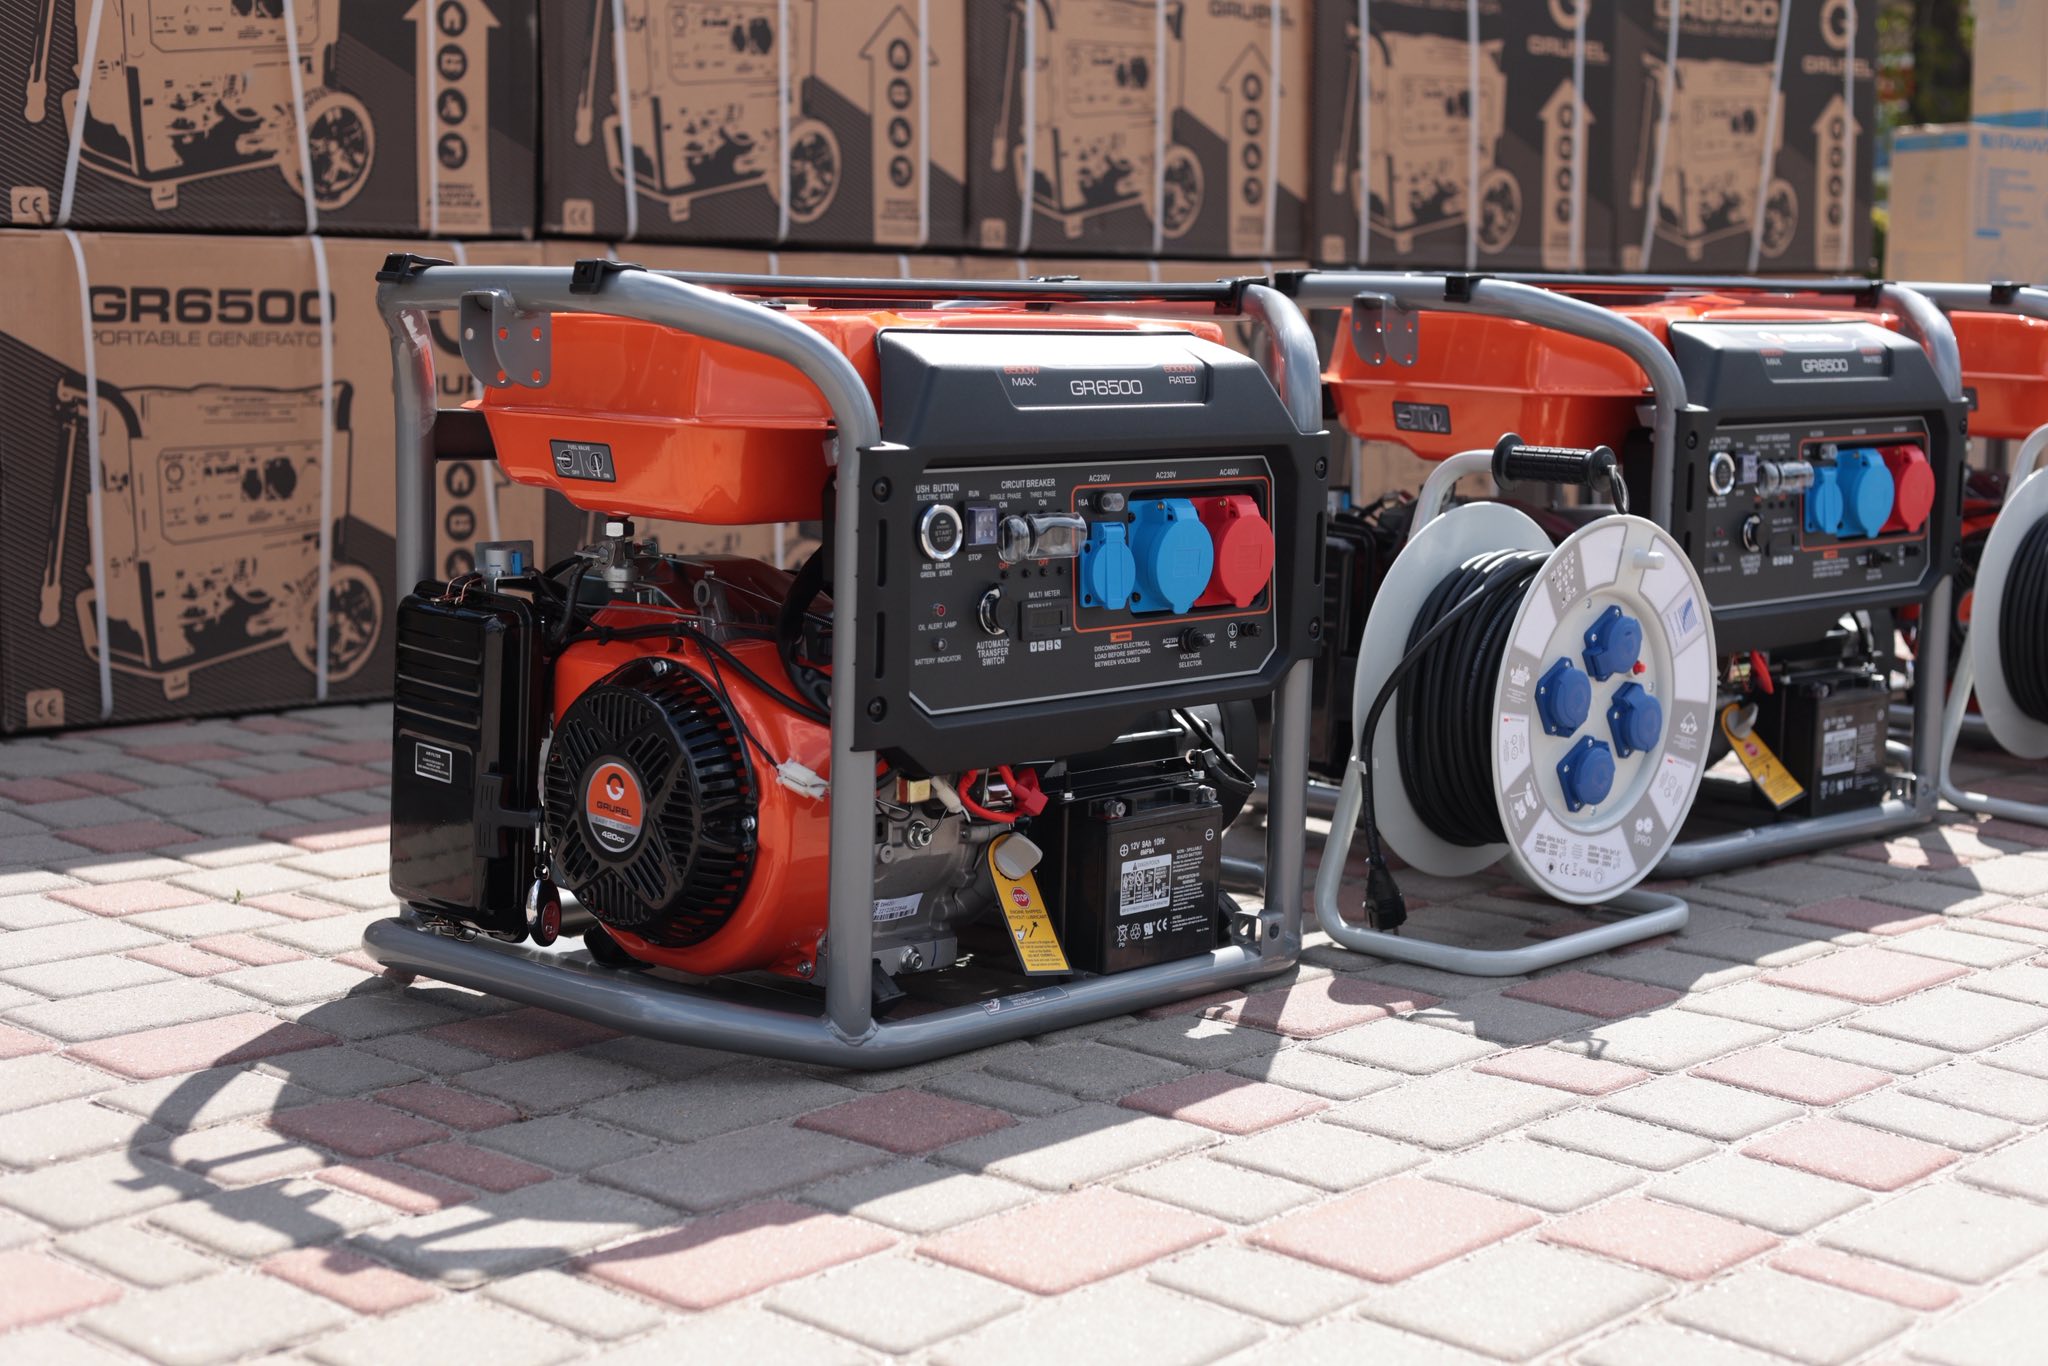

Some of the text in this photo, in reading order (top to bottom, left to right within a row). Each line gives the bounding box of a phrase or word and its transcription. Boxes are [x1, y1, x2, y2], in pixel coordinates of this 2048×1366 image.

[89, 285, 336, 325] GR6500
[1801, 358, 1849, 373] GR6500
[1168, 375, 1197, 385] RATED
[1070, 380, 1143, 396] GR6500
[1156, 471, 1177, 479] AC230V
[1219, 468, 1240, 476] AC400V
[1088, 474, 1111, 482] AC230V
[915, 483, 960, 493] USH BUTTON
[1001, 478, 1056, 489] CIRCUIT BREAKER
[1007, 492, 1022, 500] PHASE
[1078, 498, 1088, 506] 16A
[968, 554, 982, 562] STOP
[935, 562, 952, 570] ERROR
[928, 622, 943, 630] ALERT
[976, 638, 1010, 650] AUTOMATIC
[1094, 640, 1151, 652] DISCONNECT ELECTRICAL
[978, 648, 1009, 659] TRANSFER
[1126, 648, 1151, 656] SWITCHING
[1180, 652, 1200, 660] VOLTAGE
[914, 654, 962, 666] BATTERY INDICATOR
[982, 656, 1006, 667] SWITCH
[1094, 660, 1116, 668] BETWEEN
[1178, 660, 1202, 668] SELECTOR
[596, 801, 632, 817] GRUPEL
[602, 831, 625, 843] 420cc
[1130, 837, 1165, 850] 12V 9Ah 10Hr
[1013, 894, 1028, 902] STOP
[1156, 918, 1167, 932] CE
